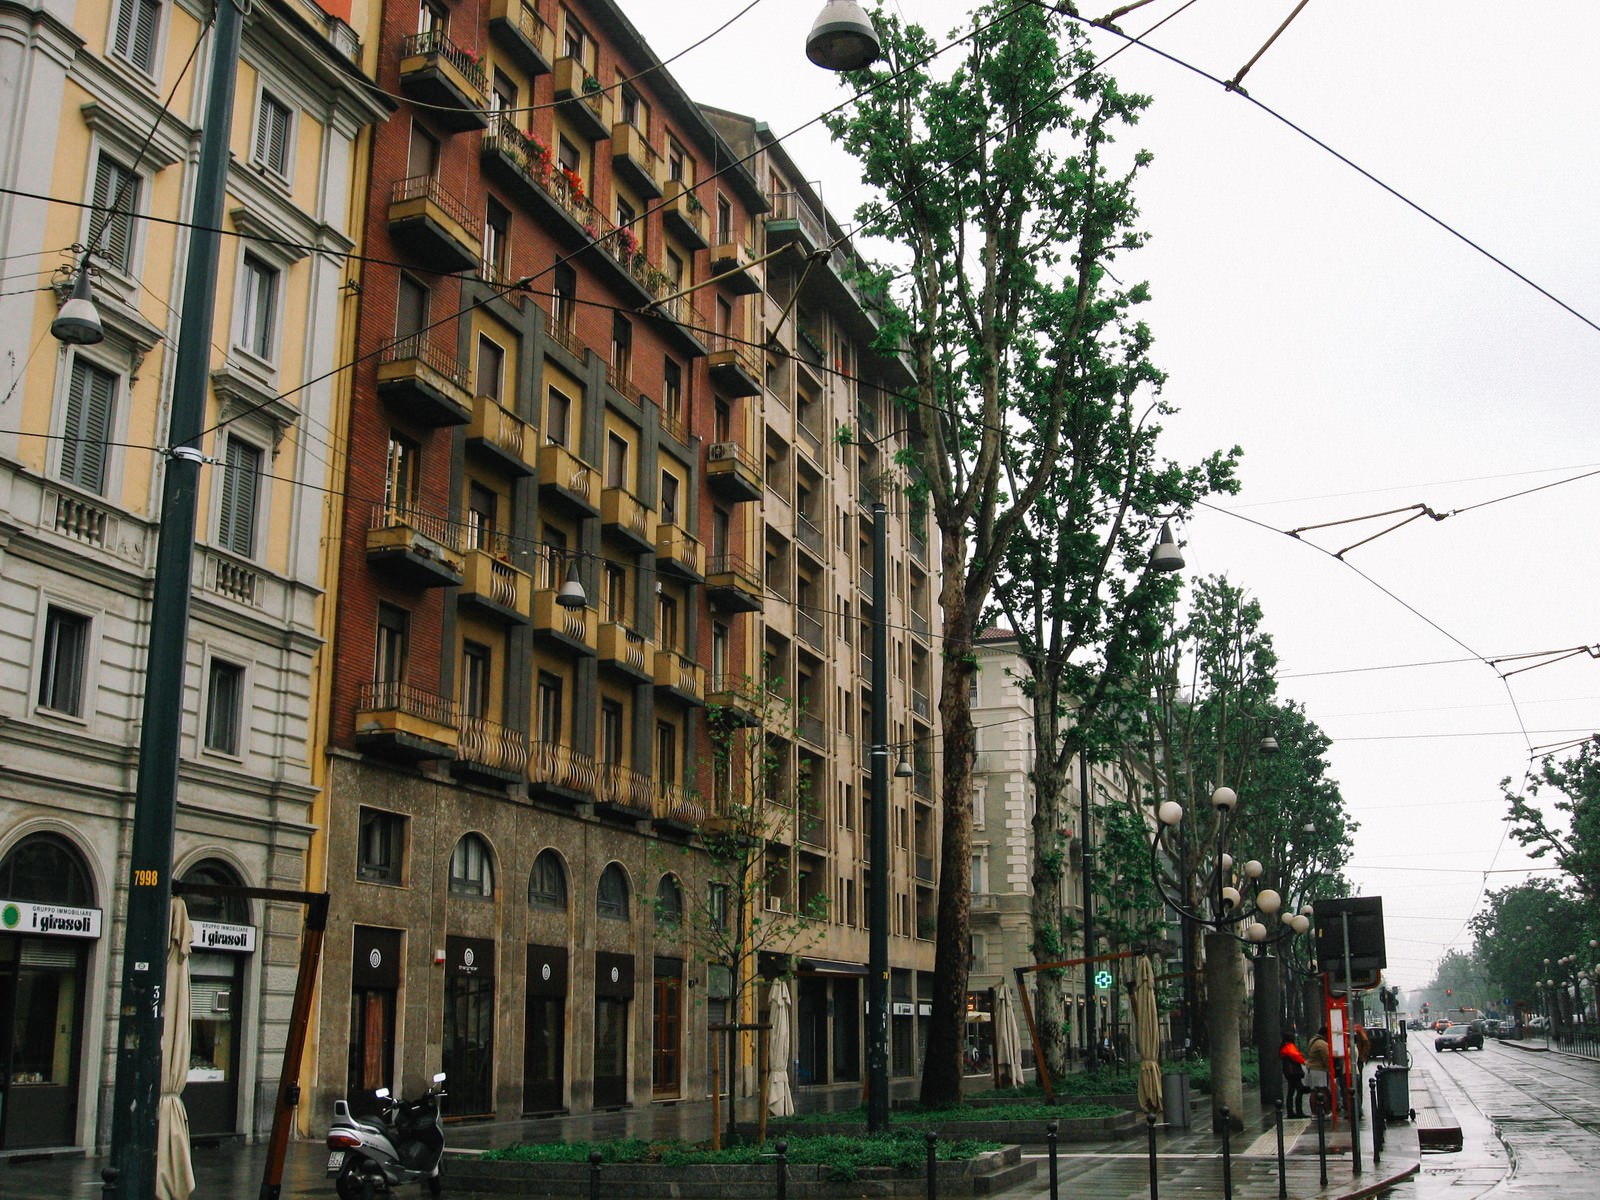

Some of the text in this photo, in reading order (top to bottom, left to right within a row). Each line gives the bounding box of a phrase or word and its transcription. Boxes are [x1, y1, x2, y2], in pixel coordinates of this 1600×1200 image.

[134, 870, 158, 886] 7998
[32, 905, 92, 917] GRUPPO IMMOBILIARE
[32, 912, 91, 932] i girasoli
[202, 929, 247, 947] i girasoli
